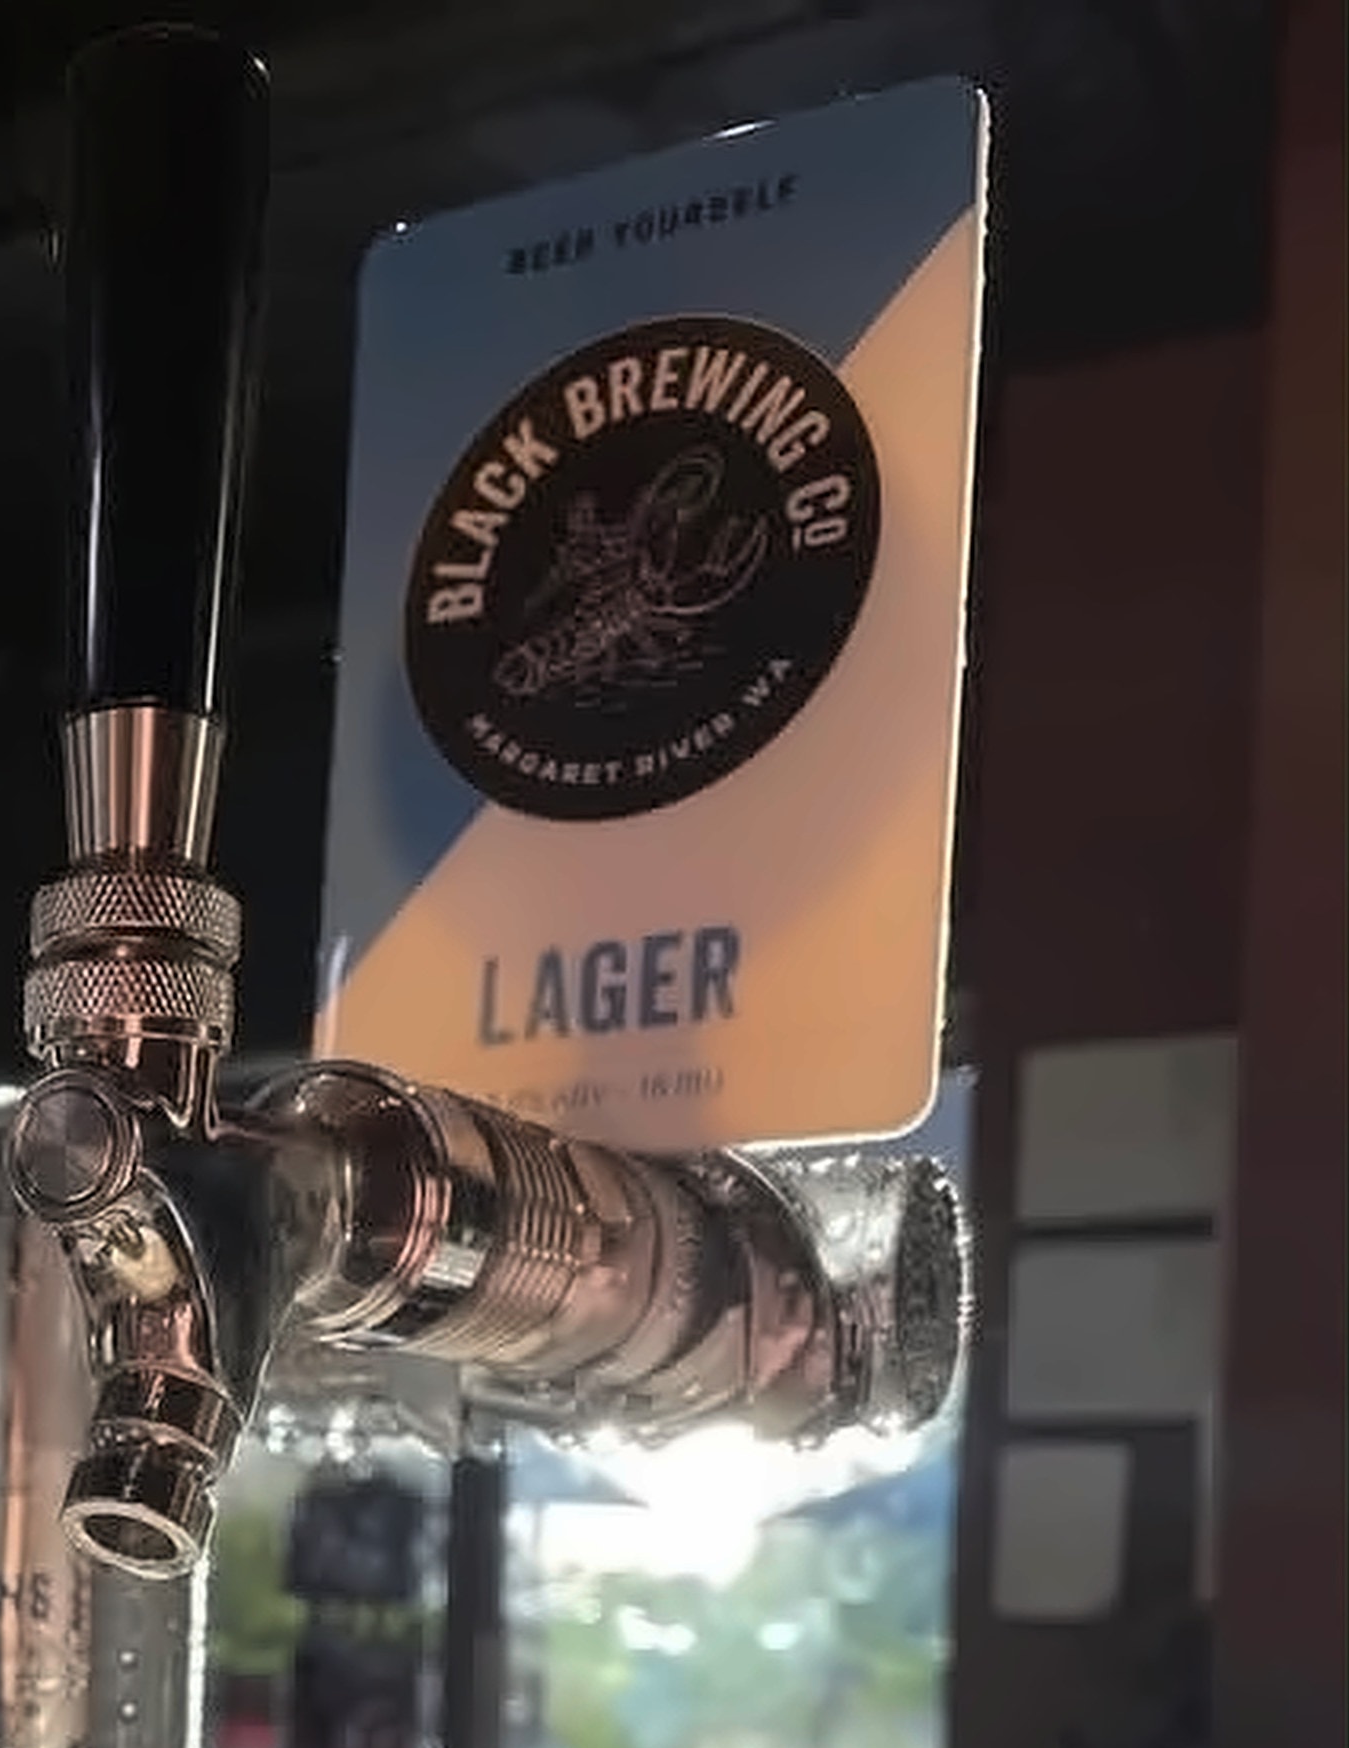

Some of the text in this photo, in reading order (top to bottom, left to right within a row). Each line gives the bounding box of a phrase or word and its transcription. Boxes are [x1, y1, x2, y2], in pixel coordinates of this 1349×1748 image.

[427, 417, 559, 626] BLACK
[563, 344, 832, 473] BREWING
[470, 713, 623, 785] MARGARET
[635, 711, 735, 772] RIVER
[476, 925, 743, 1047] LAGER
